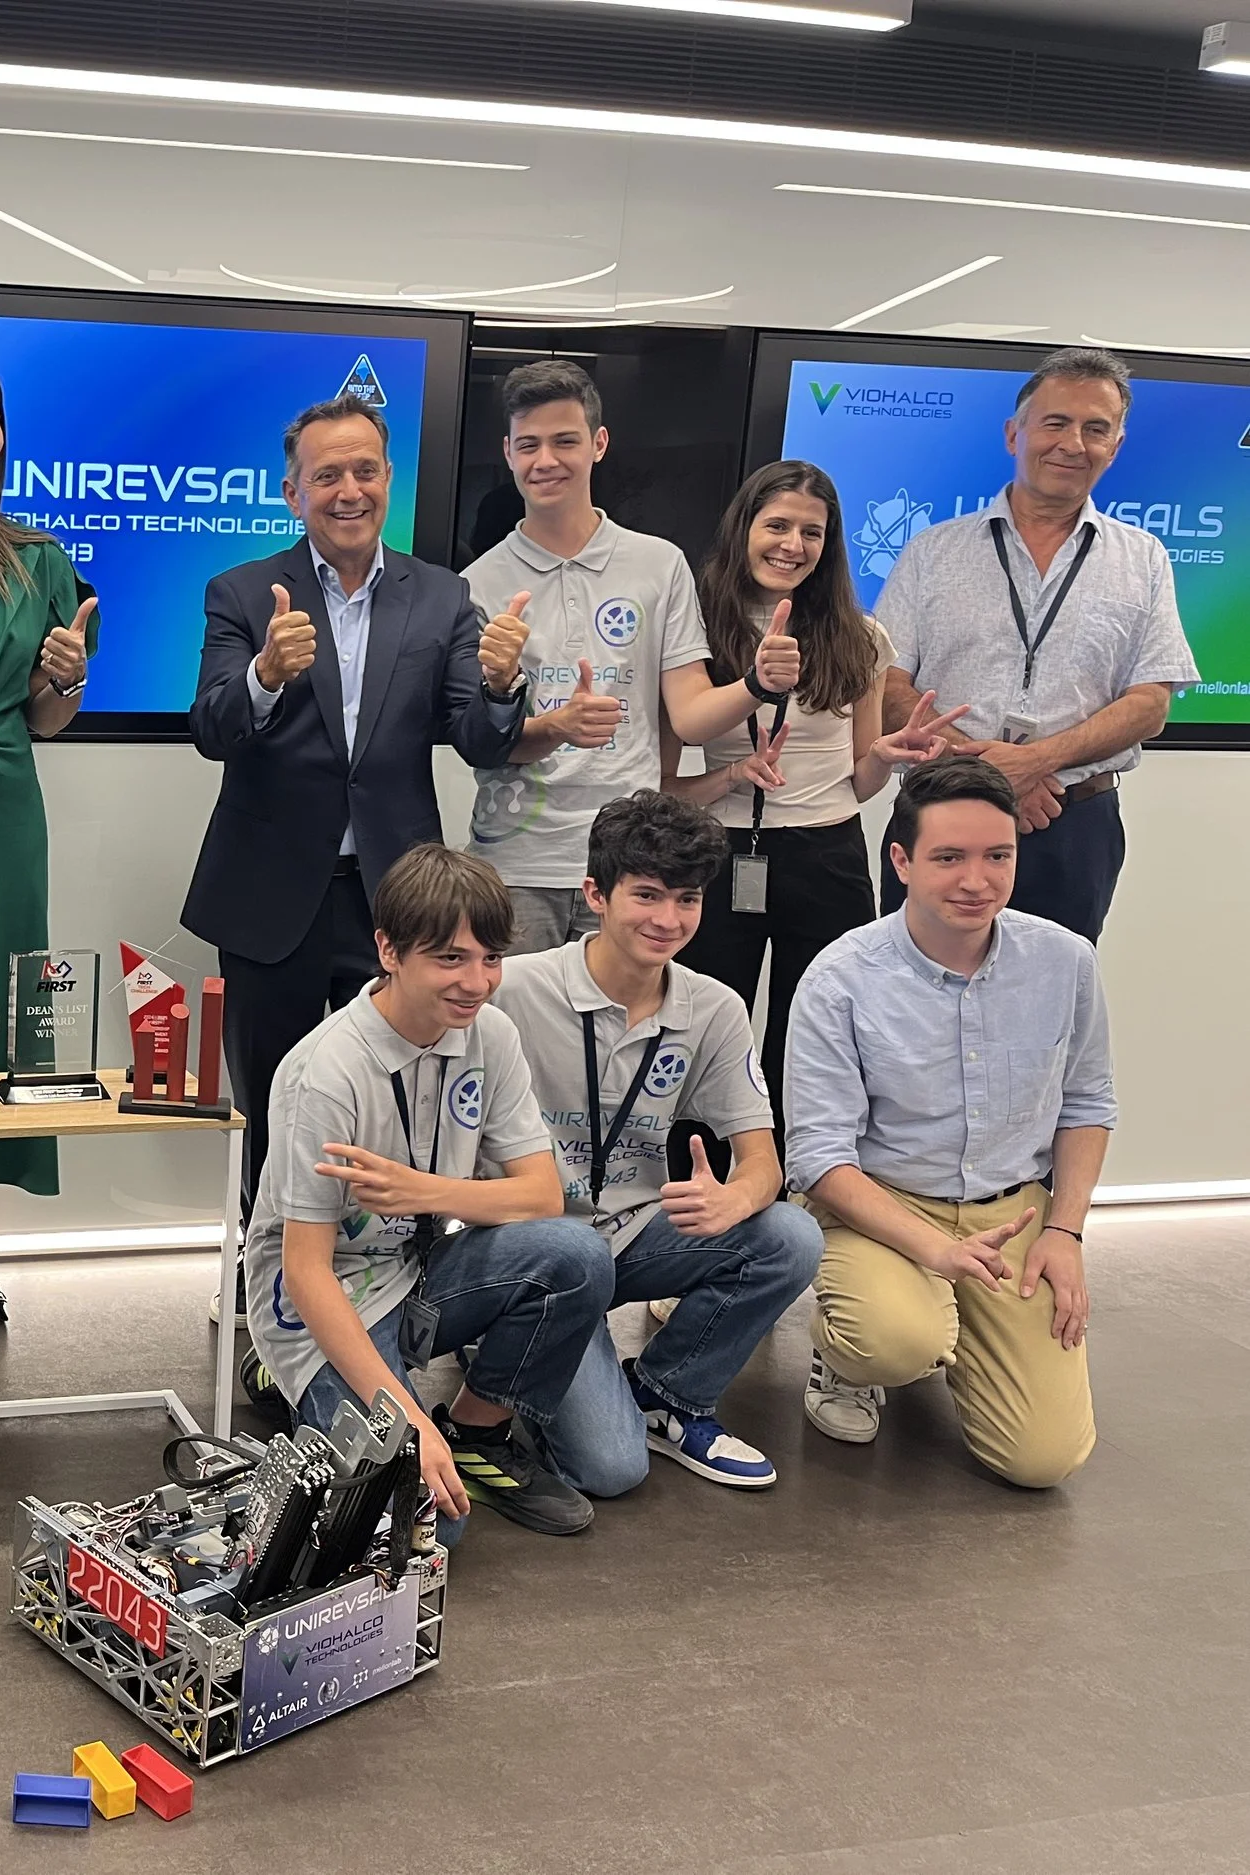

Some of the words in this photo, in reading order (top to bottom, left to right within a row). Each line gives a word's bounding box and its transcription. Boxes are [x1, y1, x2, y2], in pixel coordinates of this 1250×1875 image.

[846, 388, 954, 405] VIOHALCO
[844, 405, 953, 419] TECHNOLOGIES
[36, 981, 77, 993] FIRST
[26, 1005, 63, 1016] DEAN'S
[66, 1004, 88, 1014] LIST
[38, 1016, 76, 1027] AWARD
[35, 1028, 78, 1038] WINNER
[69, 1547, 162, 1651] 22043
[305, 1614, 384, 1654] VIOHALCO
[305, 1629, 384, 1667] TECHNOLOGIES
[268, 1696, 308, 1724] ALTAIR
